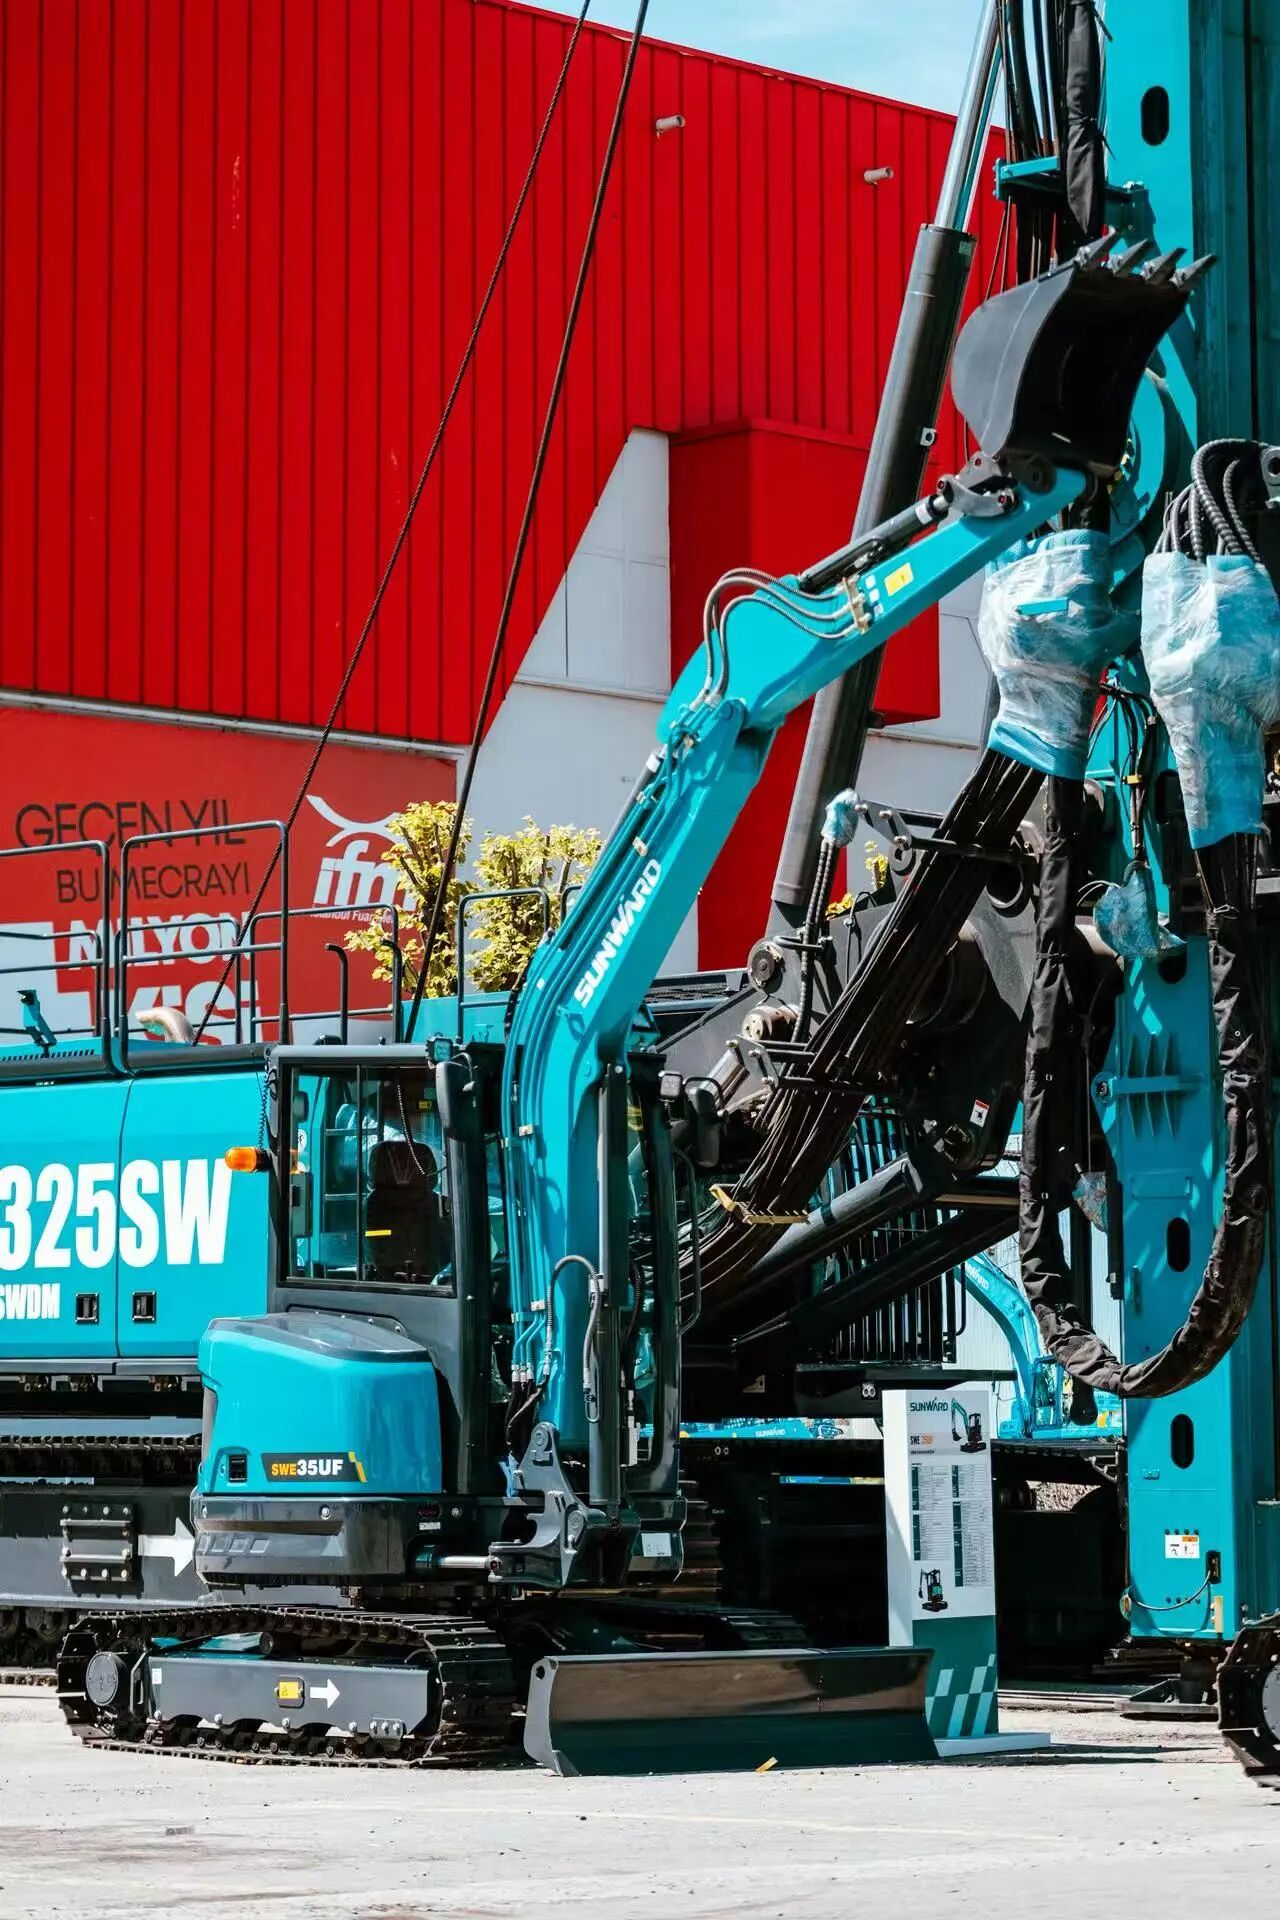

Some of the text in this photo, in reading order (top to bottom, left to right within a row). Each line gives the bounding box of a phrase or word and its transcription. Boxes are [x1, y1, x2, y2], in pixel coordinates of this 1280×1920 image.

[181, 799, 245, 846] YIL
[57, 862, 251, 903] BU MECRAYI
[573, 858, 662, 1009] SUNWARD
[0, 1159, 233, 1271] 325SW
[910, 1397, 949, 1412] SUNWARD
